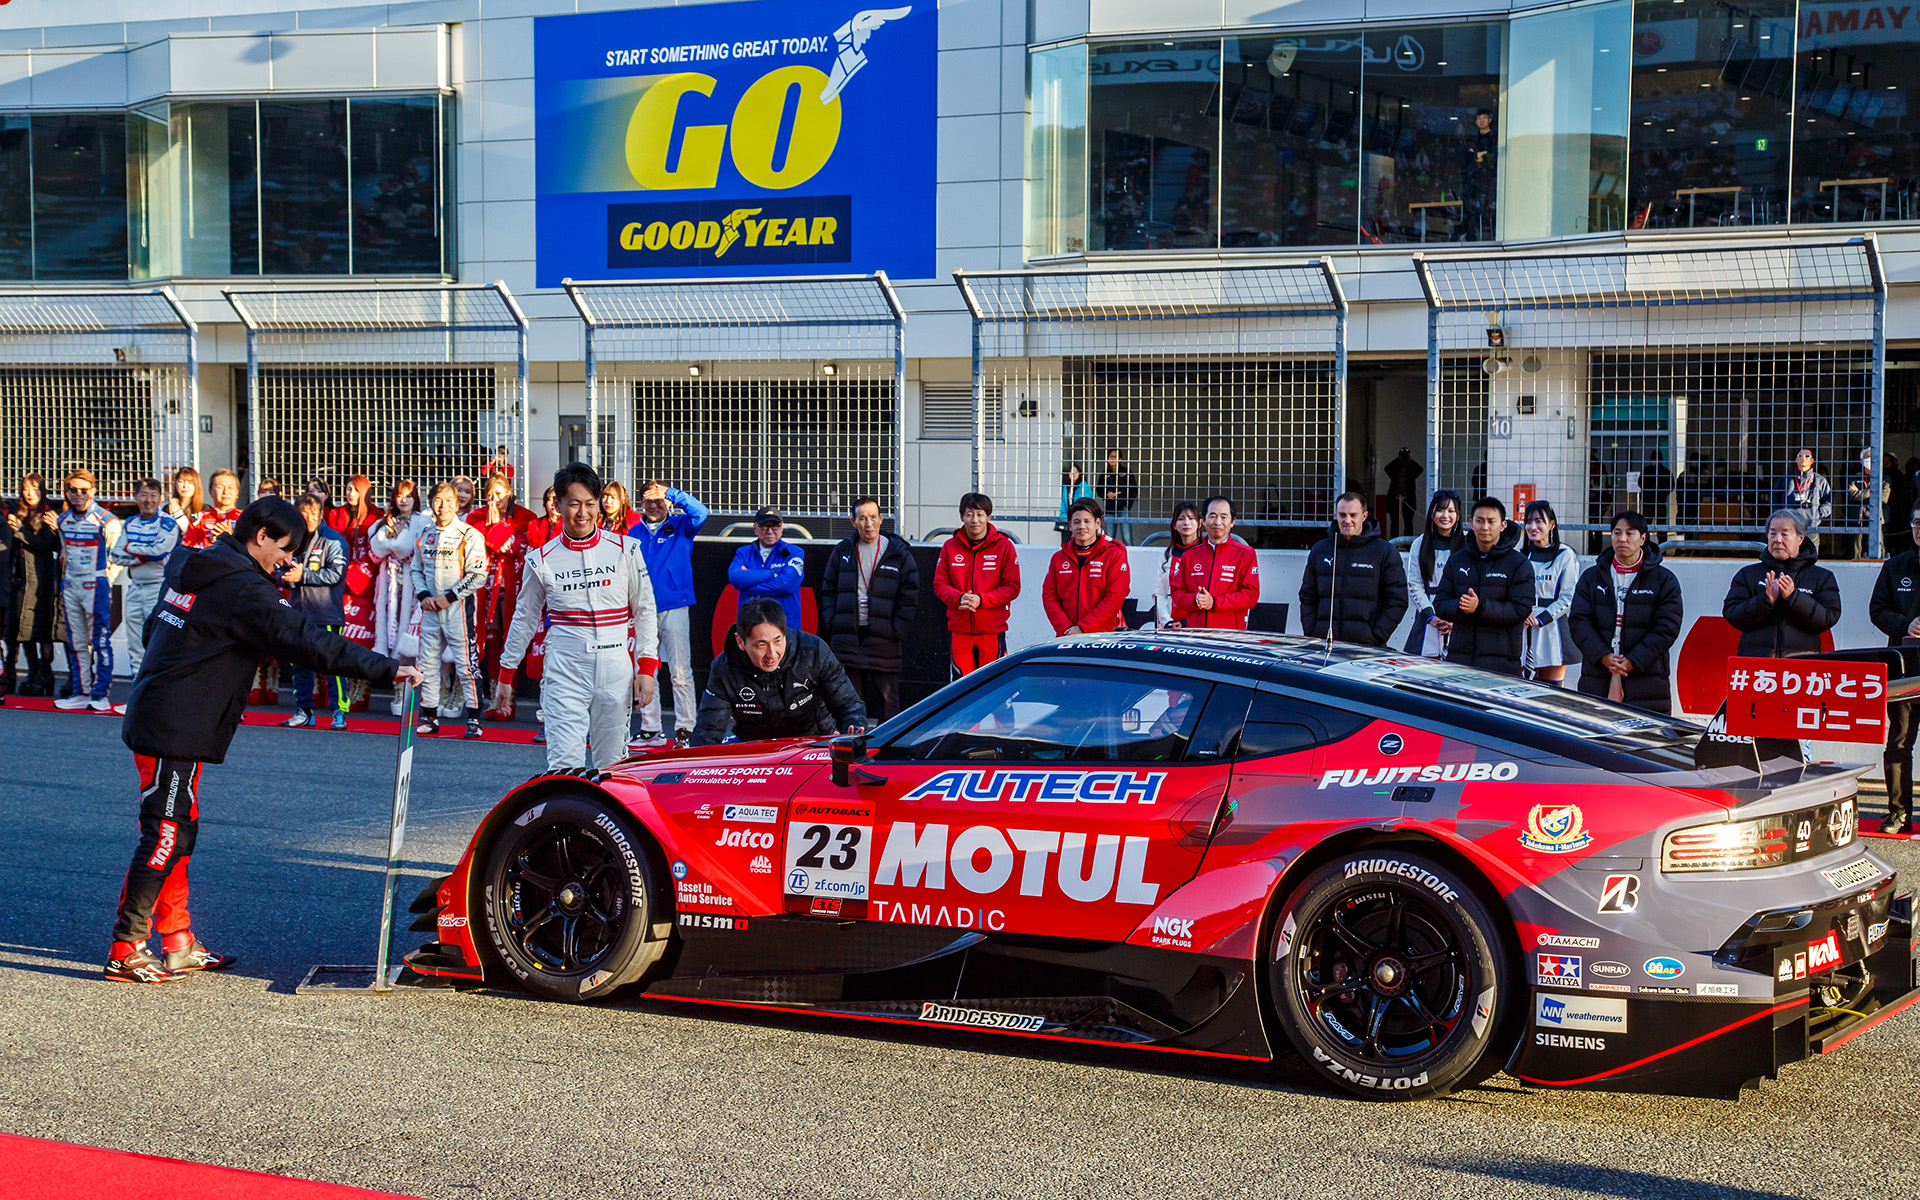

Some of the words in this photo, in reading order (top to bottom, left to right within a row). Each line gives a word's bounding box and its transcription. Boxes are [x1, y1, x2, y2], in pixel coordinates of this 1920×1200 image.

[606, 48, 649, 67] START
[650, 42, 730, 64] SOMETHING
[732, 39, 780, 60] GREAT
[781, 36, 829, 56] TODAY.
[625, 65, 842, 190] GO
[1492, 419, 1511, 436] 10
[555, 565, 616, 581] NISSAN
[562, 579, 611, 591] nismo
[1076, 641, 1137, 650] K.CHIYO
[1163, 646, 1266, 666] R.QUINTARELLI
[1729, 669, 1883, 699] #ありがとう
[1796, 707, 1881, 730] ロニー
[1707, 733, 1753, 744] TOOLS
[689, 768, 728, 776] NISMO
[728, 767, 775, 776] SPORTS
[775, 767, 793, 776] OIL
[1317, 761, 1519, 790] FUJITSUBO
[732, 777, 744, 786] by
[899, 769, 1168, 804] AUTECH
[738, 808, 759, 816] AQUA
[761, 809, 776, 817] TEC
[808, 806, 871, 817] AUTOBACS
[1797, 820, 1811, 840] 40
[1841, 808, 1852, 839] 23
[715, 828, 775, 849] Jatco
[795, 824, 862, 871] 23
[594, 812, 643, 909] BRIDGESTONE
[750, 855, 772, 868] MAC
[874, 821, 1160, 905] MOTUL
[678, 881, 702, 892] Asset
[703, 882, 712, 893] in
[815, 879, 866, 895] zf.com/jp
[1345, 859, 1459, 903] BRIDGESTONE
[678, 892, 698, 903] Auto
[699, 893, 733, 906] Service
[813, 898, 840, 910] ETS
[679, 914, 749, 931] nismo
[873, 900, 1005, 931] TAMADIC
[485, 884, 529, 981] POTENZA
[1153, 916, 1195, 939] NGK
[1152, 936, 1171, 946] SPARK
[1172, 938, 1192, 948] PLUGS
[1550, 935, 1598, 948] TAMACHI
[1593, 964, 1628, 974] SUNRAY
[1539, 975, 1580, 987] TAMIYA
[919, 1002, 1044, 1031] BRIDGESTONE
[1566, 1011, 1623, 1024] weathernews
[1535, 1033, 1606, 1050] SIEMENS
[1313, 1045, 1429, 1090] POTENZA
